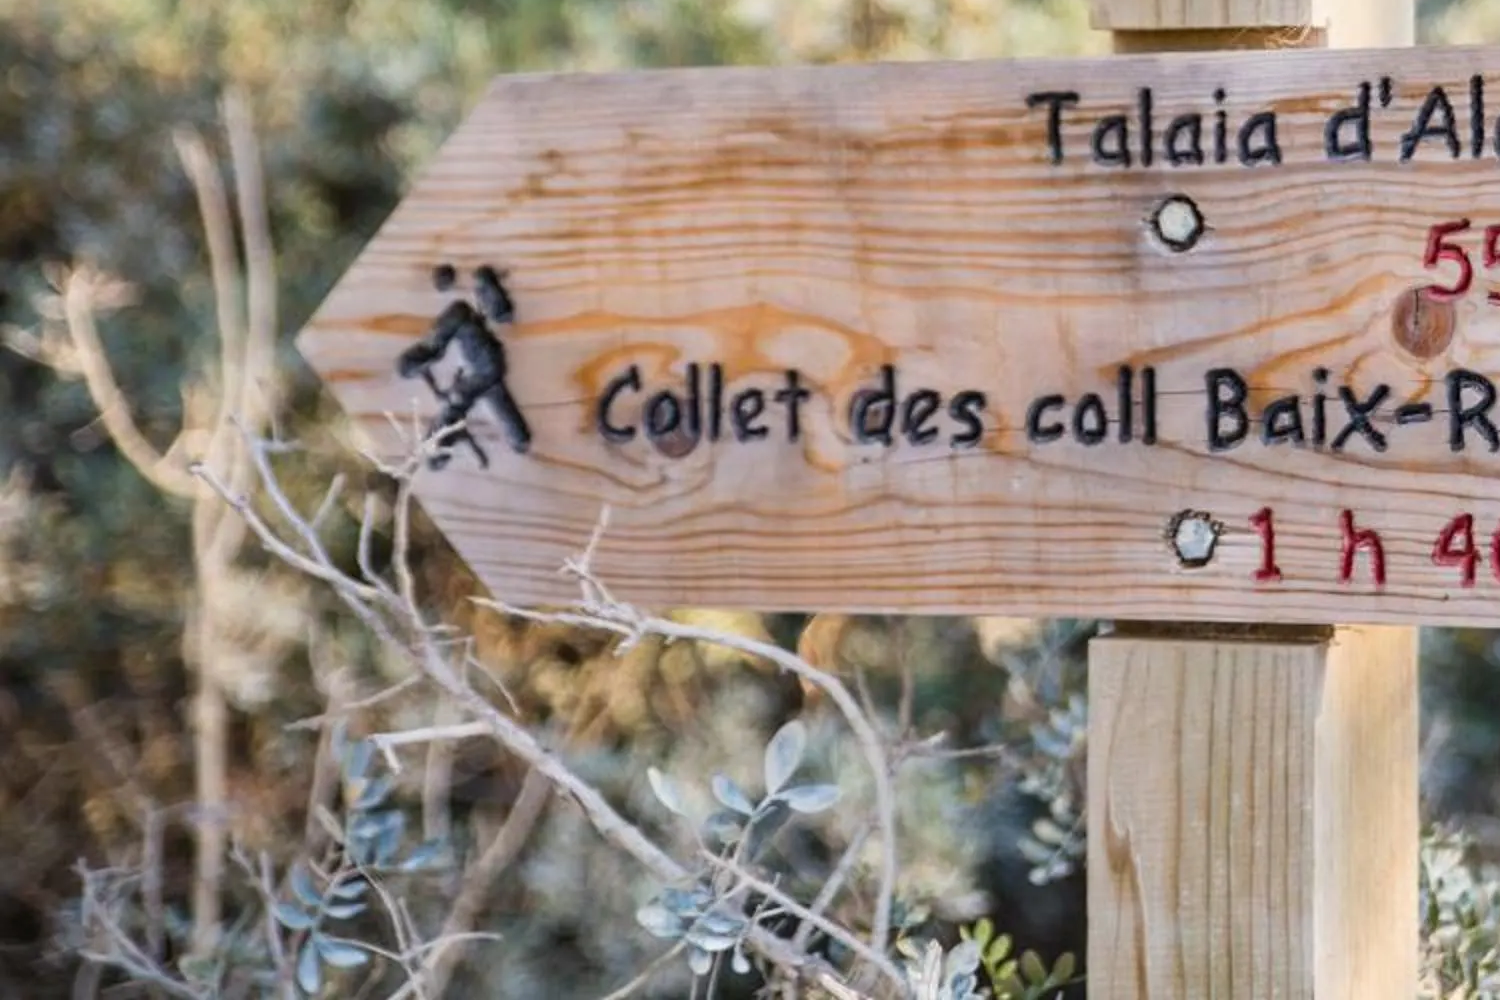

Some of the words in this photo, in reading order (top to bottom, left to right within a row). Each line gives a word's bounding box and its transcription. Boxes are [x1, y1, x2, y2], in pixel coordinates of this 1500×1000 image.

[1027, 86, 1283, 168] Talaia
[599, 361, 810, 445] Collet
[848, 363, 987, 448] des
[1024, 363, 1158, 446] coll
[1247, 506, 1283, 584] 1
[1338, 508, 1387, 589] h
